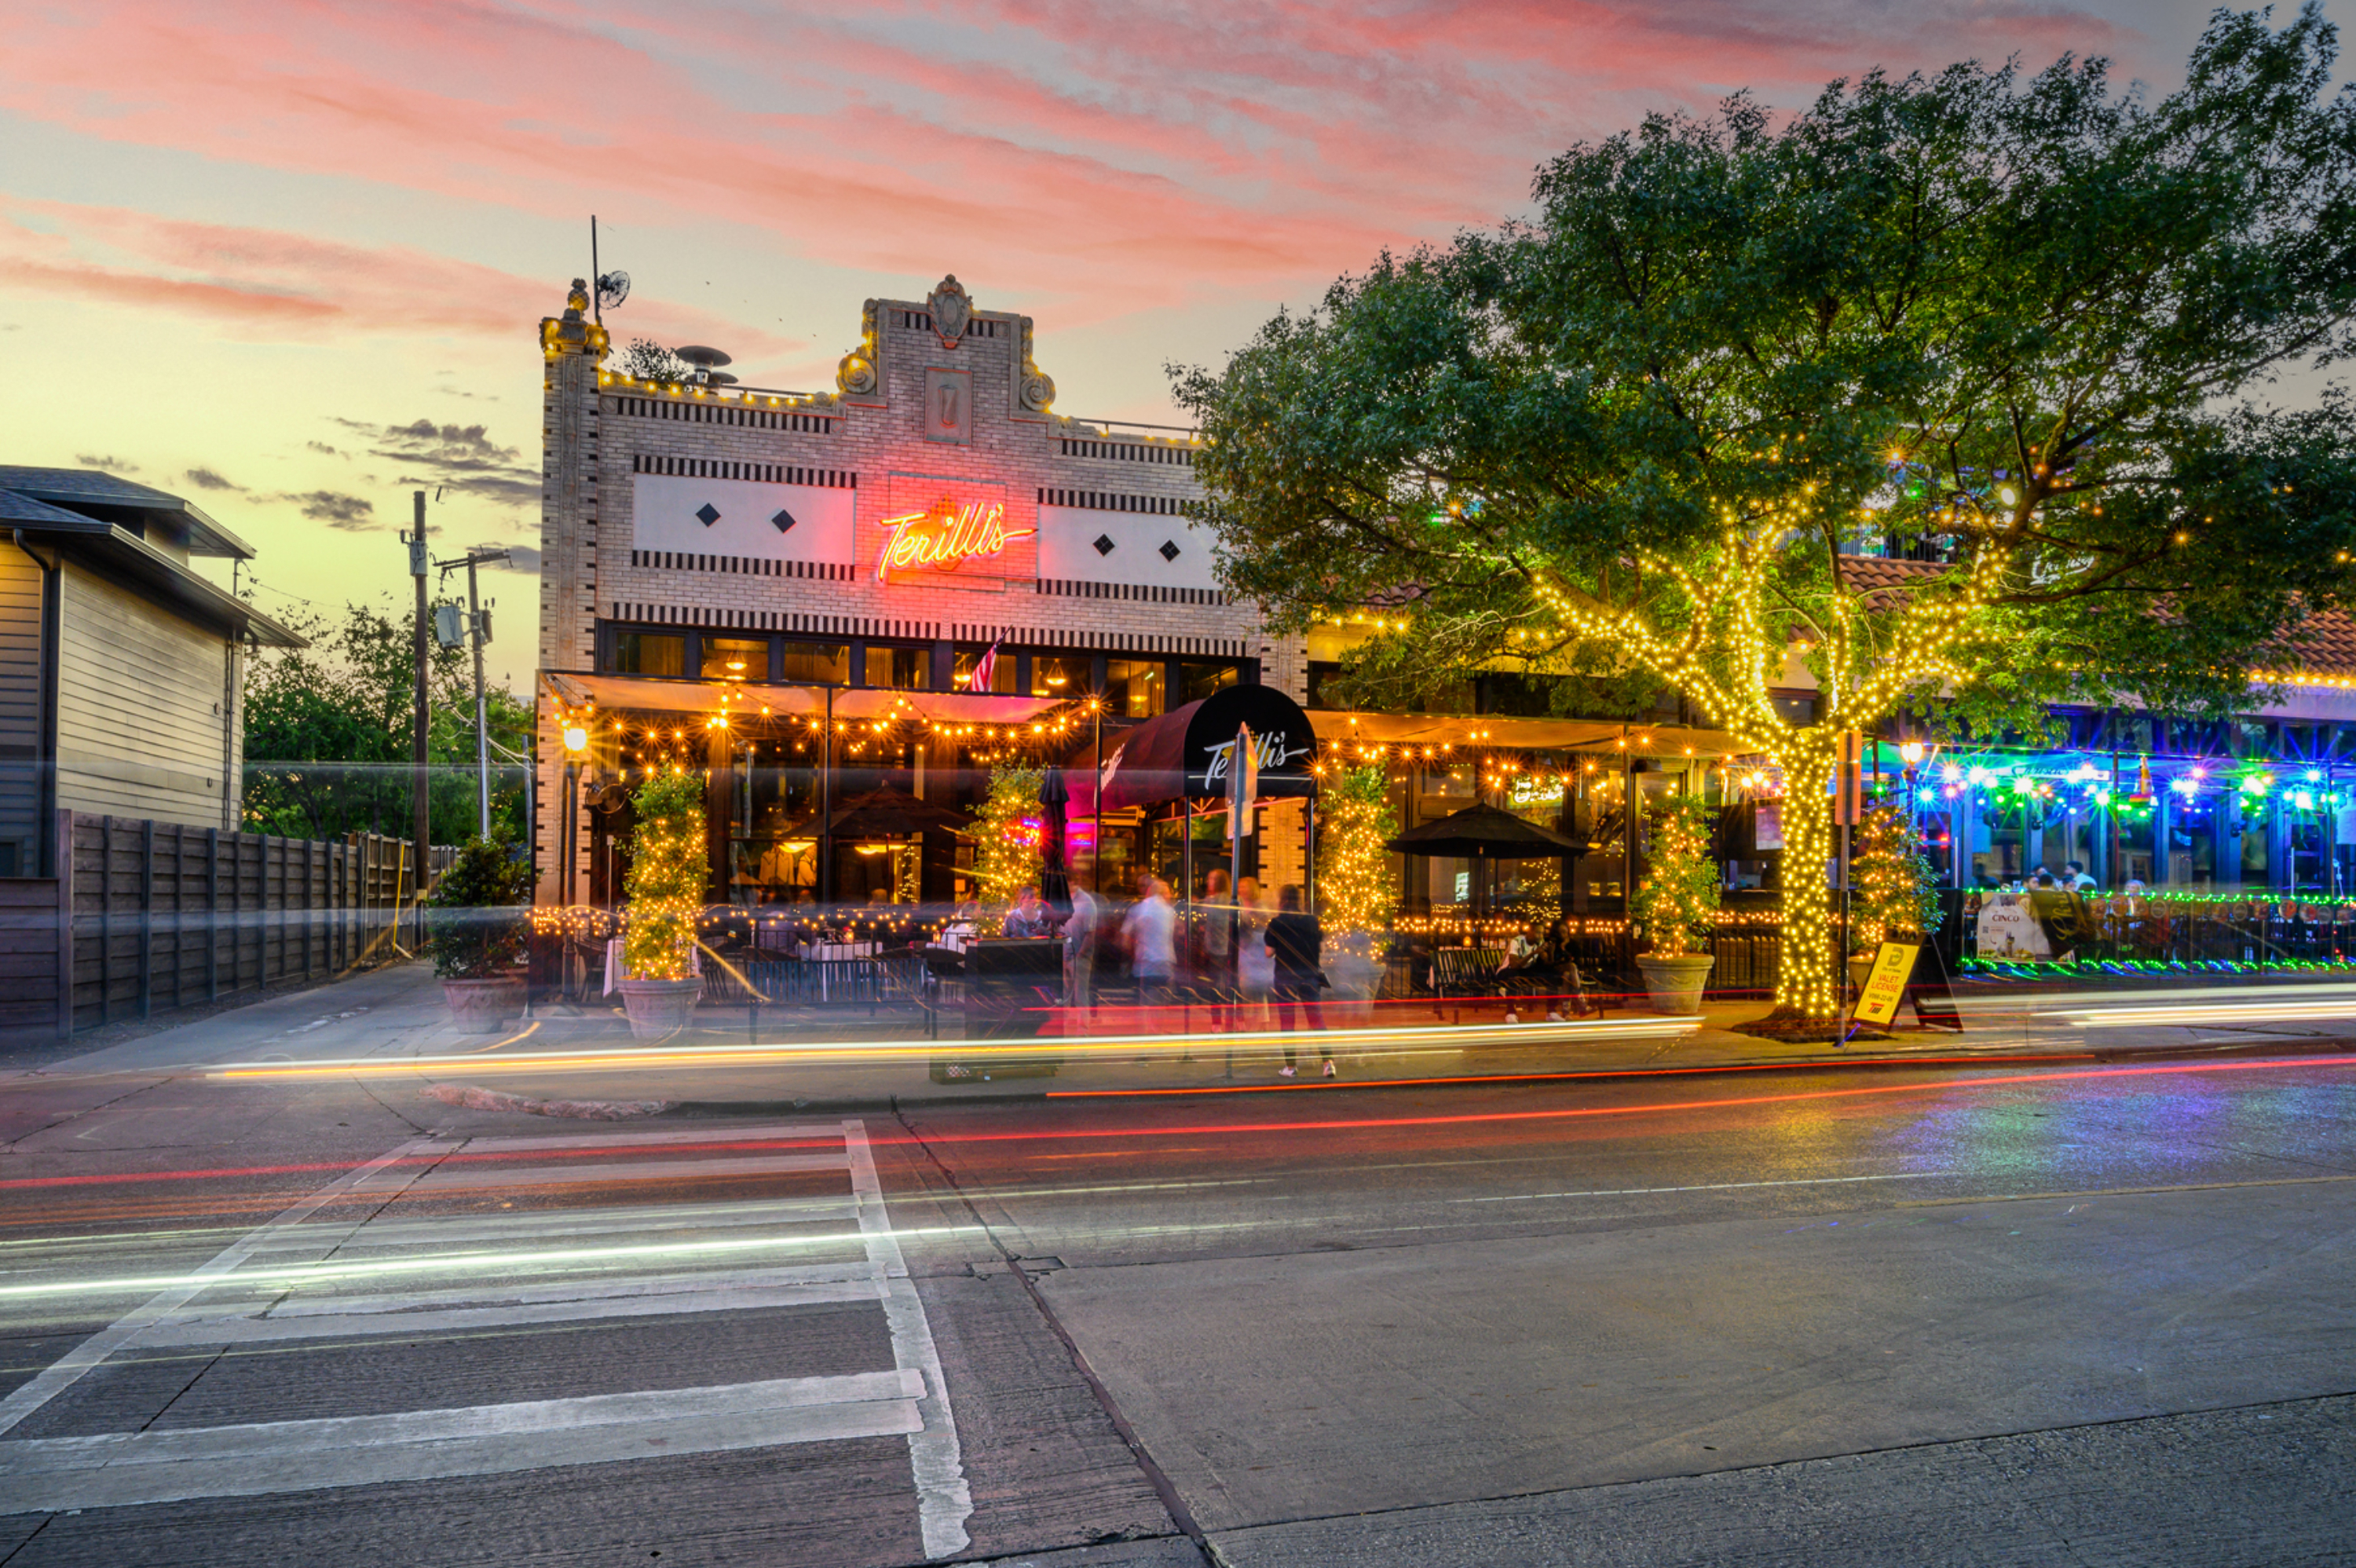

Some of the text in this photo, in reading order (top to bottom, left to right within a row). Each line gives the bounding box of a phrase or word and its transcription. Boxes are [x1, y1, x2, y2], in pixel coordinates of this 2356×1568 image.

[879, 501, 1038, 582] Terilli's
[1204, 732, 1309, 790] Telli's
[1992, 914, 2020, 923] CINCO
[1879, 974, 1899, 983] VALET
[1871, 981, 1899, 992] LICENSE
